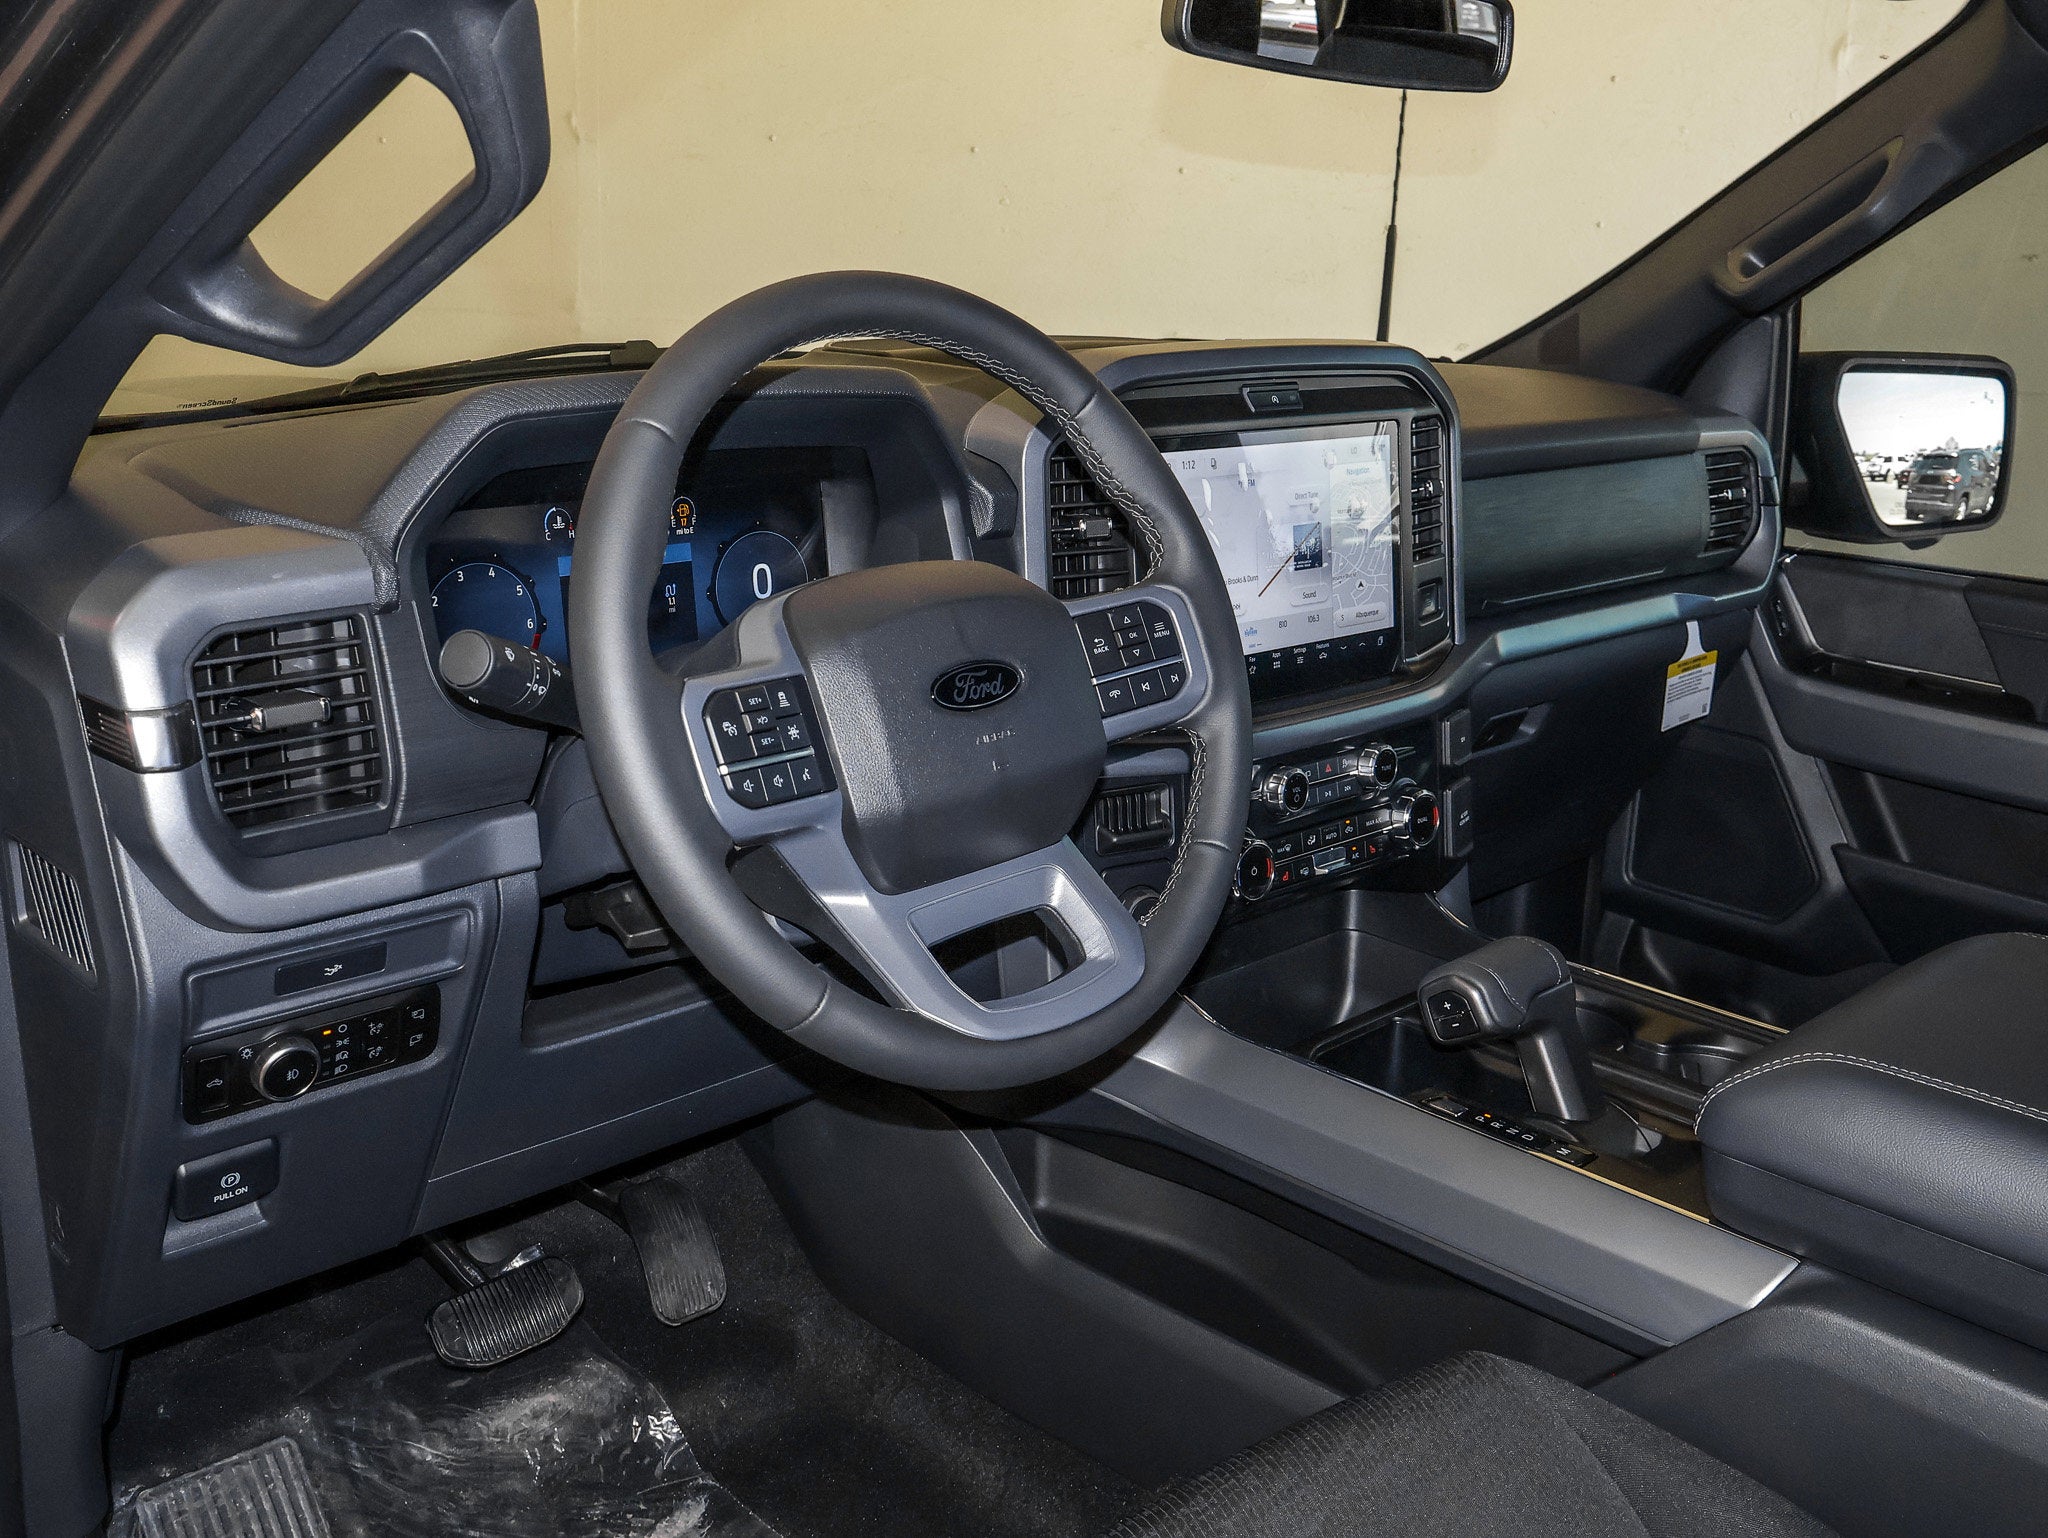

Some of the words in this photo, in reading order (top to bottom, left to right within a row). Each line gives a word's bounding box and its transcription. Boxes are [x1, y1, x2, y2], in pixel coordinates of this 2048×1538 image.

[1182, 460, 1196, 470] 1:12
[671, 519, 677, 528] E
[680, 518, 687, 526] 17
[545, 532, 551, 541] C
[568, 529, 575, 539] H
[456, 570, 464, 582] 3
[488, 566, 496, 578] 4
[752, 562, 773, 600] 0
[516, 584, 524, 596] 5
[431, 595, 439, 607] 2
[527, 618, 534, 629] 6
[1154, 630, 1170, 639] MENU
[1093, 646, 1109, 655] BACK
[953, 669, 1005, 703] Ford
[213, 1191, 235, 1203] PULL
[235, 1186, 248, 1195] ON
